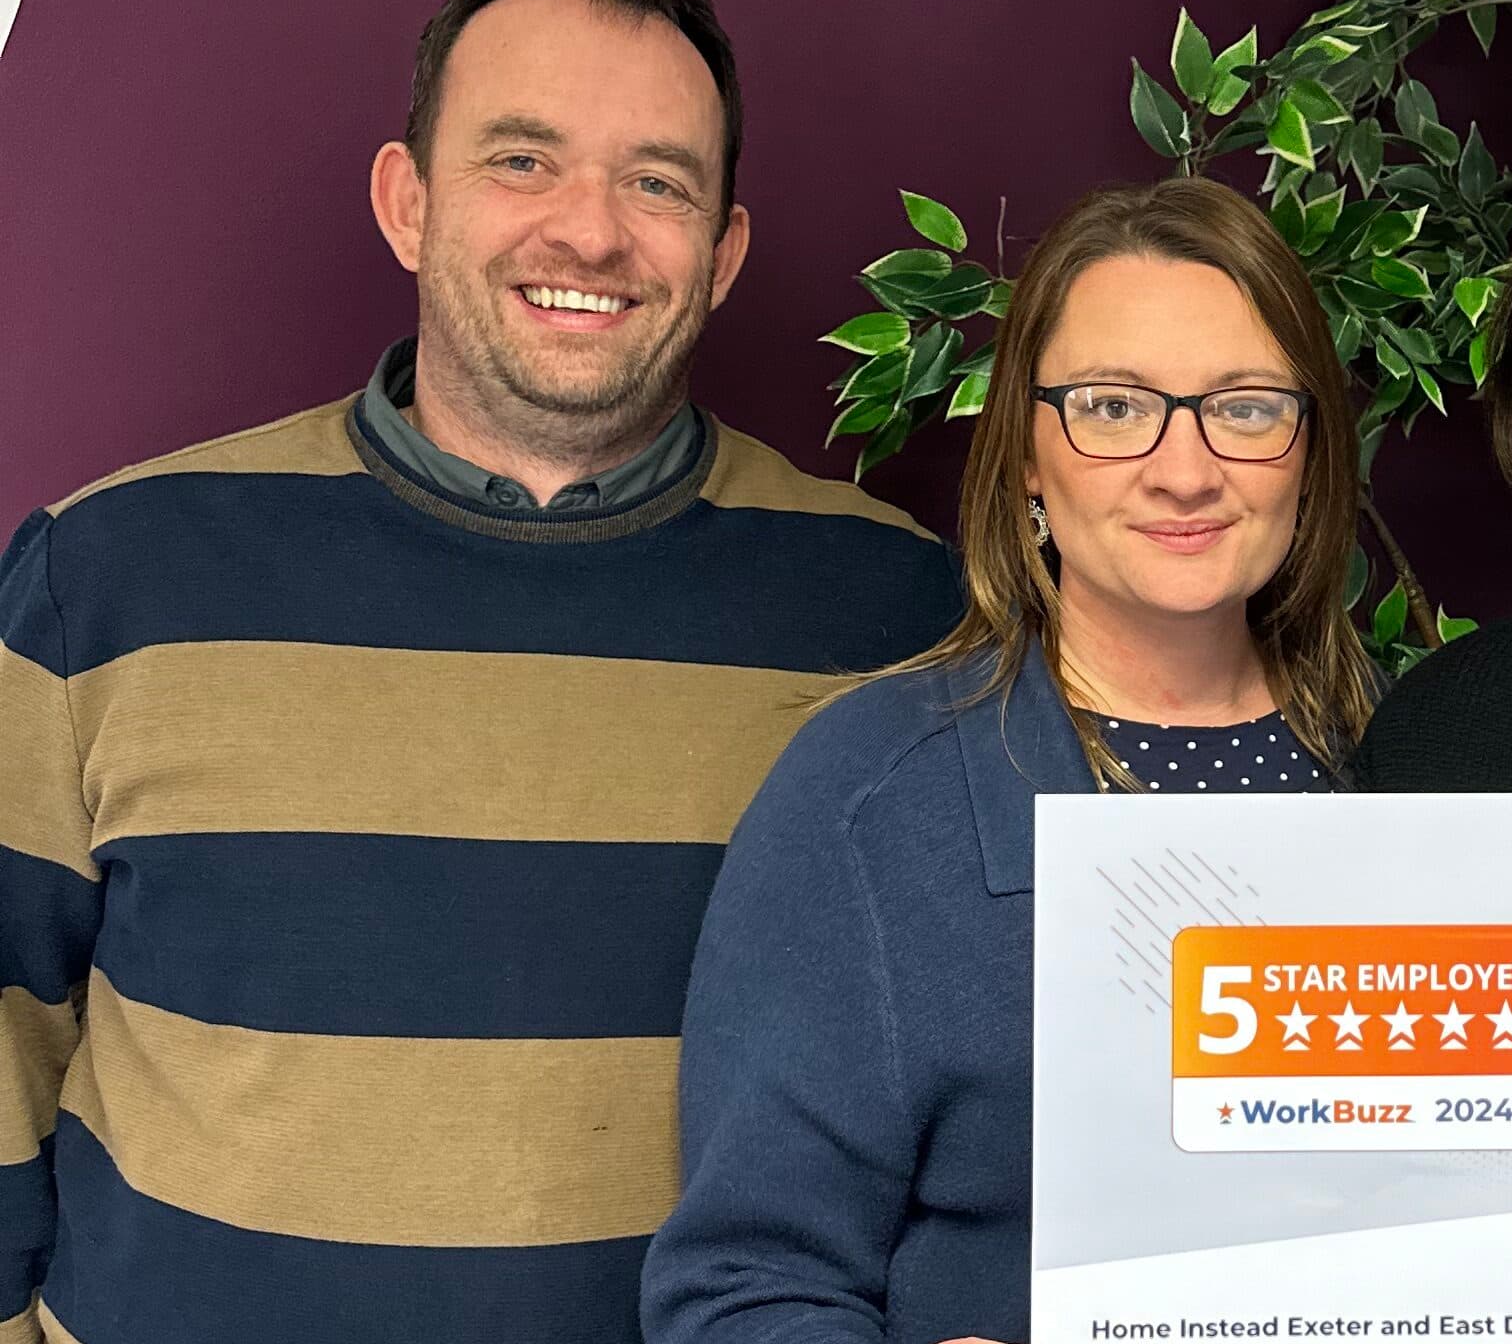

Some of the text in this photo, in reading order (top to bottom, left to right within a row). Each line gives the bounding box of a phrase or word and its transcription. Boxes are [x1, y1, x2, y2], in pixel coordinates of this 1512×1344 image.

[1198, 964, 1260, 1055] 5
[1263, 964, 1348, 992] STAR
[1240, 1098, 1415, 1125] WorkBuzz
[1092, 1318, 1171, 1340] Home
[1180, 1316, 1278, 1339] Instead
[1288, 1315, 1374, 1338] Exeter
[1380, 1314, 1431, 1337] and
[1439, 1314, 1496, 1336] East
